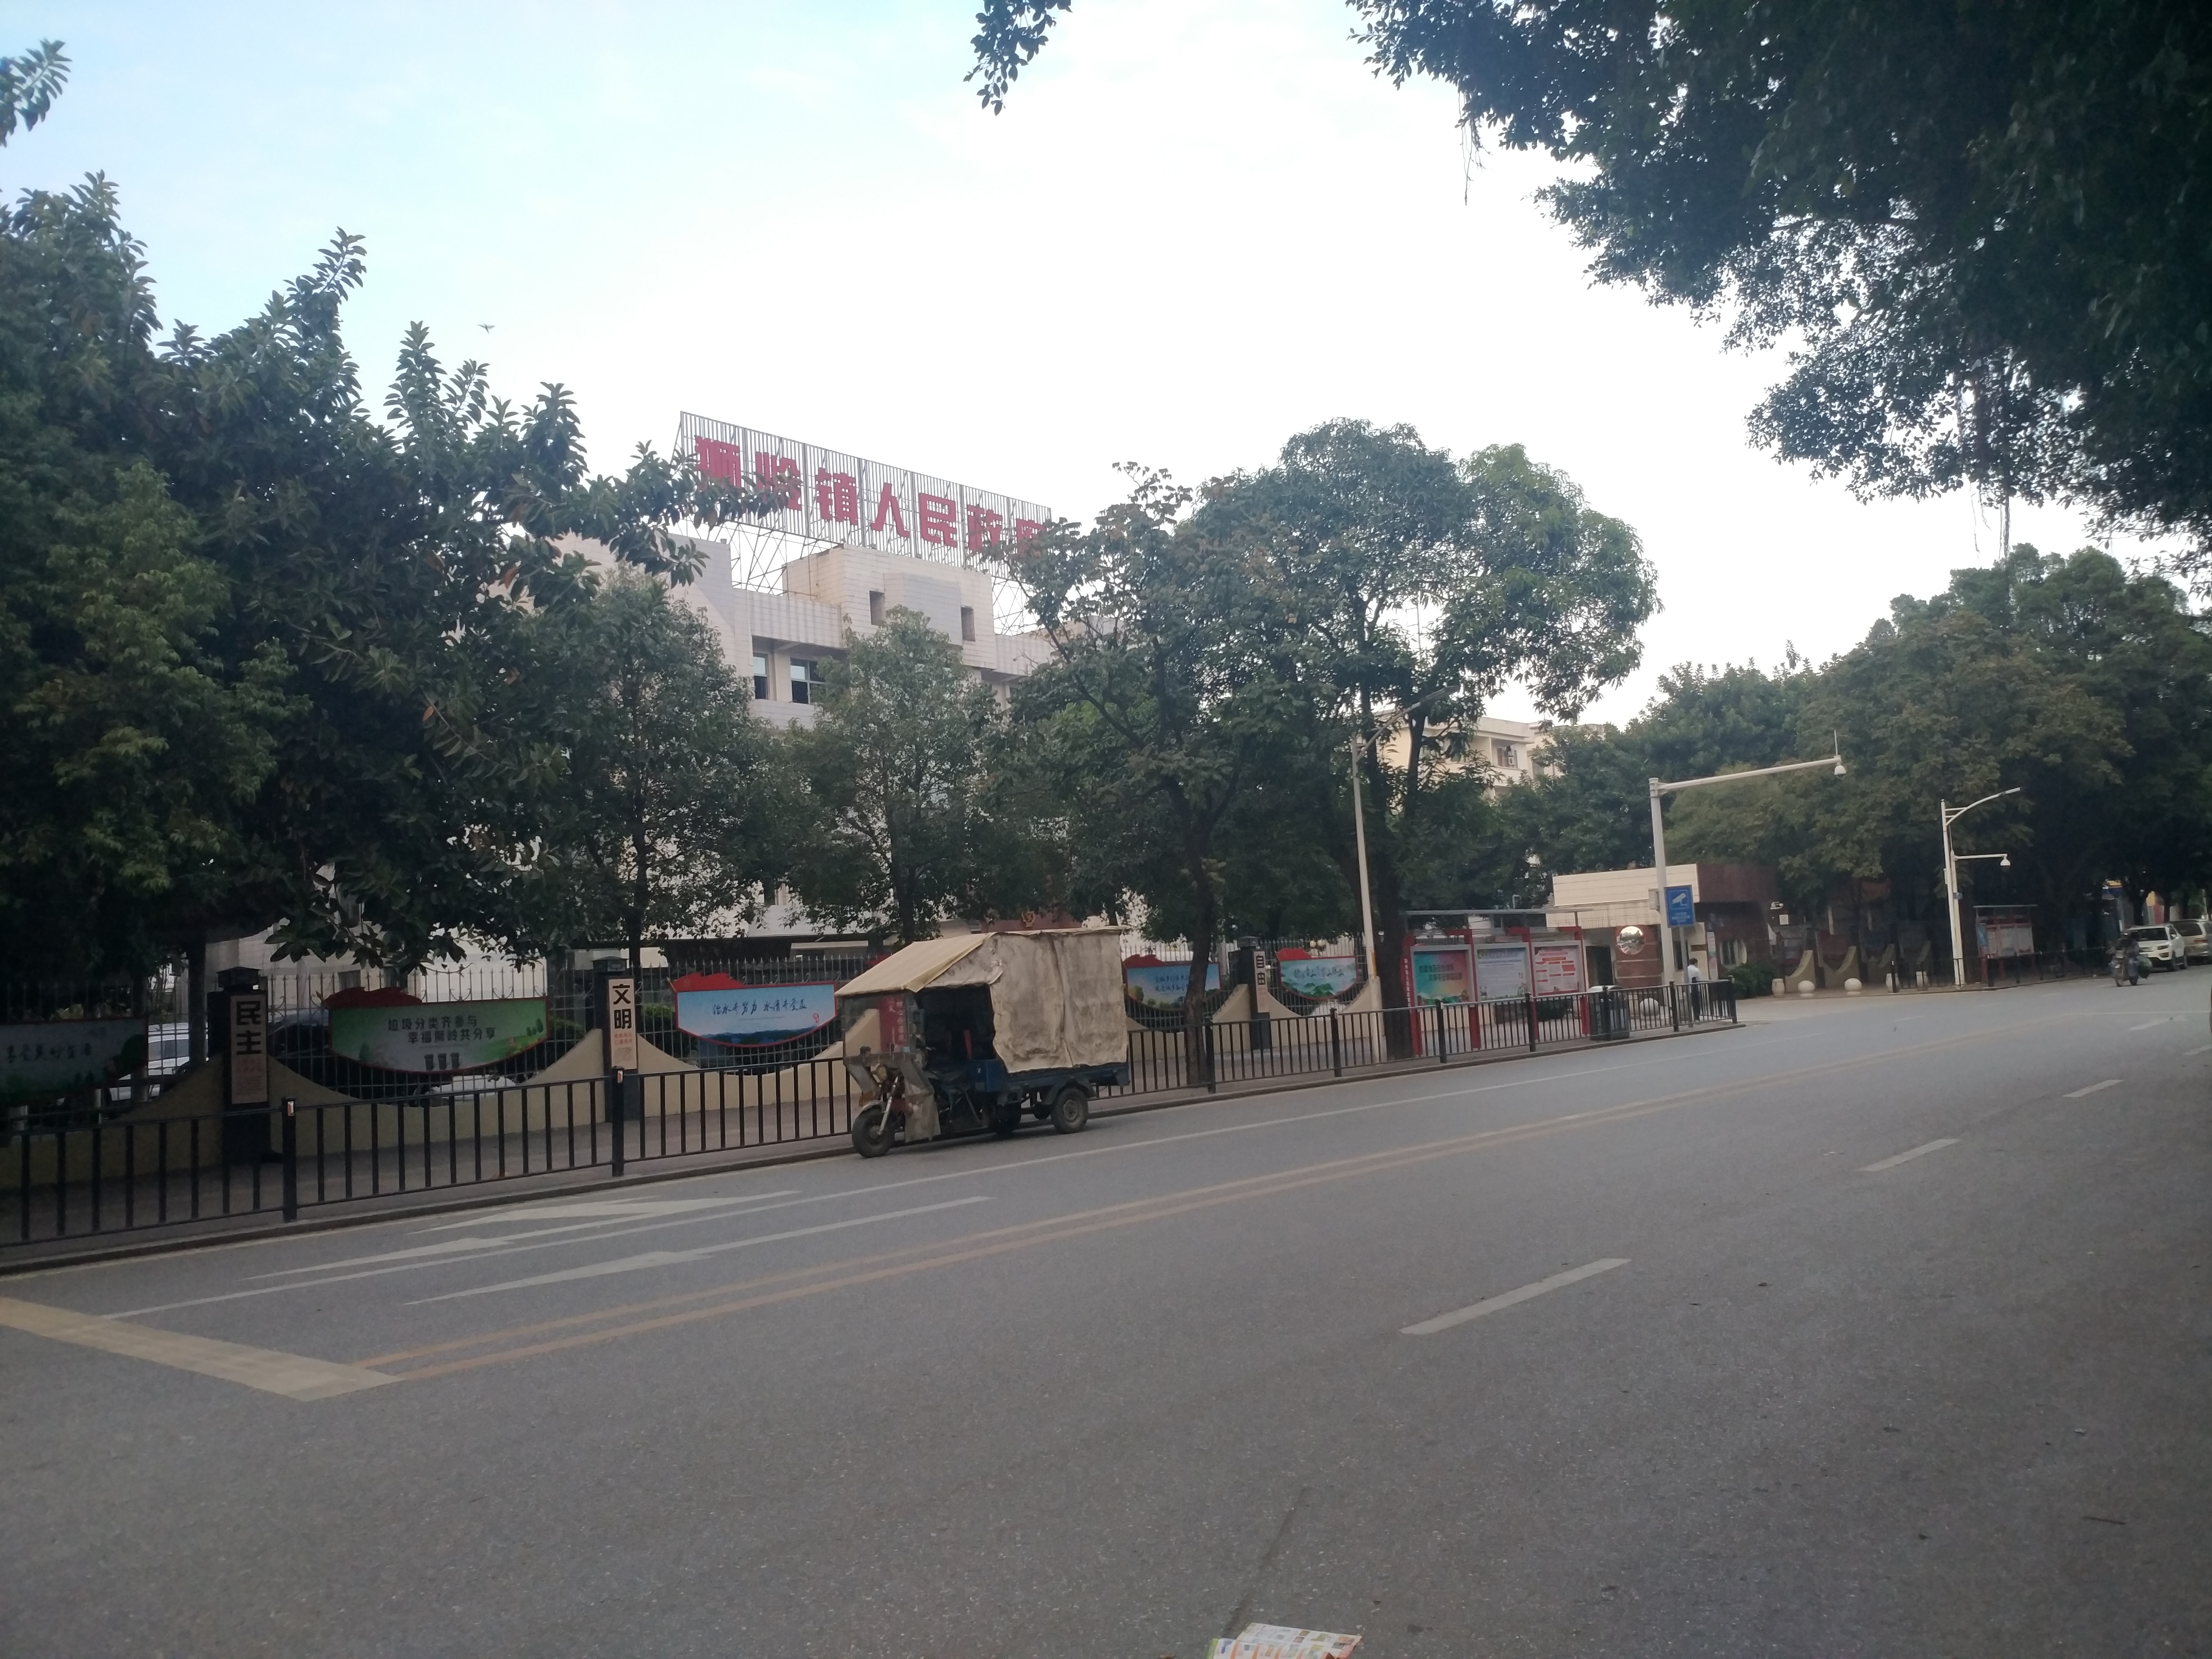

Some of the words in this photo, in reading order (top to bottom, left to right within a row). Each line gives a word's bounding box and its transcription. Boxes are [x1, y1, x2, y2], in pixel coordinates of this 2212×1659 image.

[1255, 954, 1266, 985] 自由
[612, 984, 632, 1029] 文明
[236, 1000, 262, 1055] 民主
[388, 1015, 477, 1031] 垃圾分类齐参与
[407, 1027, 496, 1044] 幸福狮岭共分享
